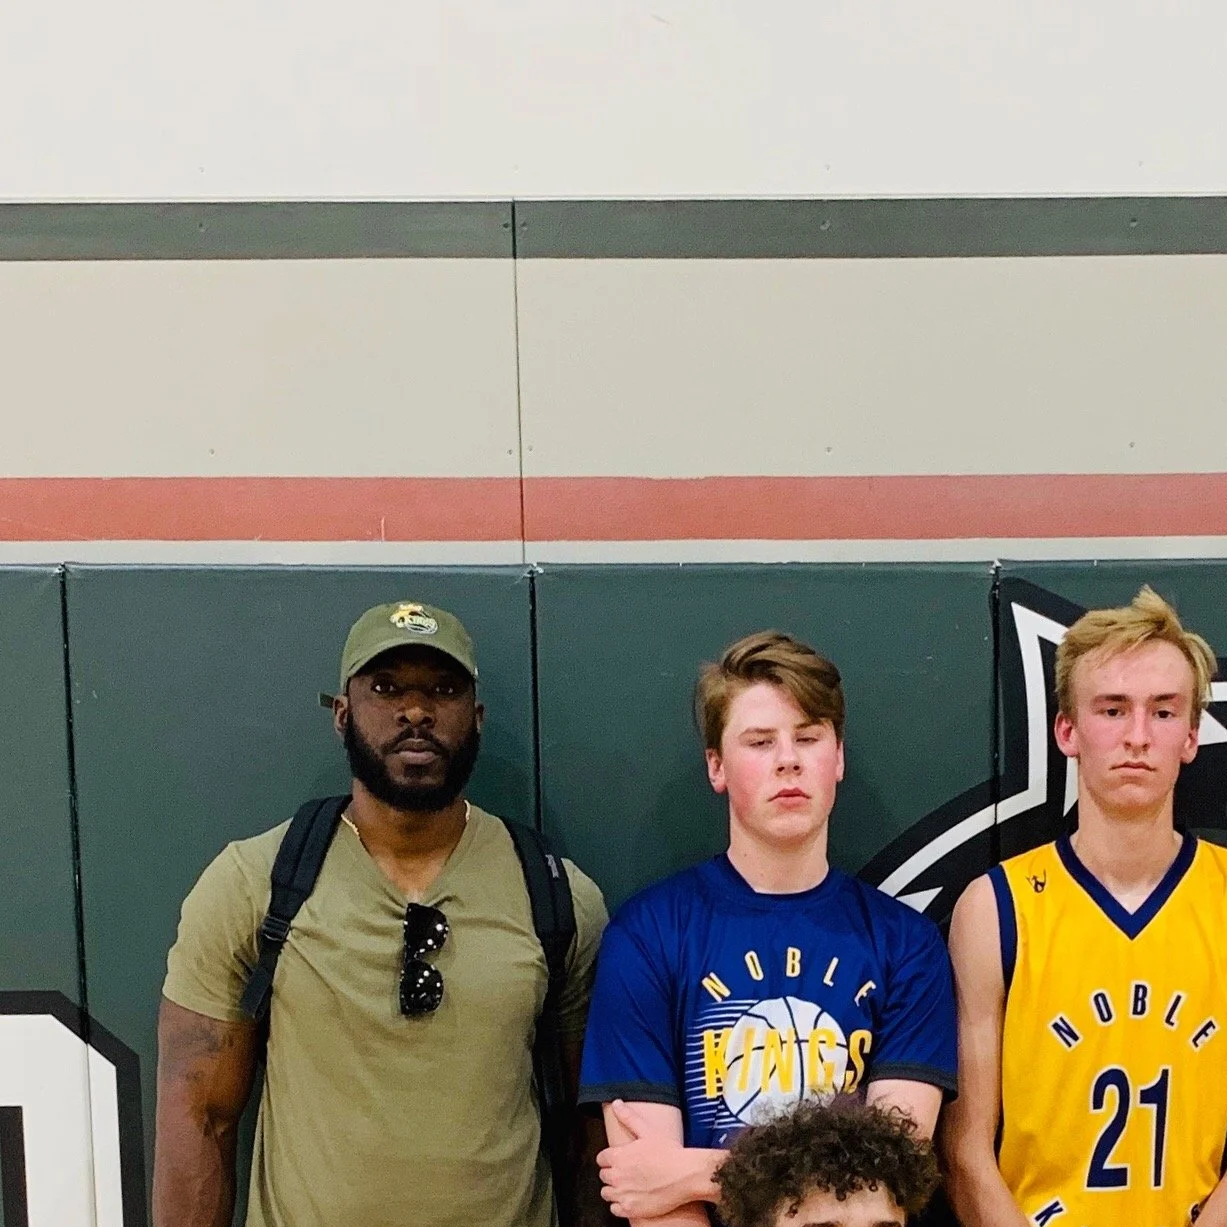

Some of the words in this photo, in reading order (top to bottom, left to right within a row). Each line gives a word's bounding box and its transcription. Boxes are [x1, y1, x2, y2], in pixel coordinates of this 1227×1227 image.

[702, 946, 877, 1008] NOBLE
[1049, 982, 1219, 1049] NOBLE
[703, 1027, 873, 1099] KINGS
[1086, 1067, 1171, 1189] 21
